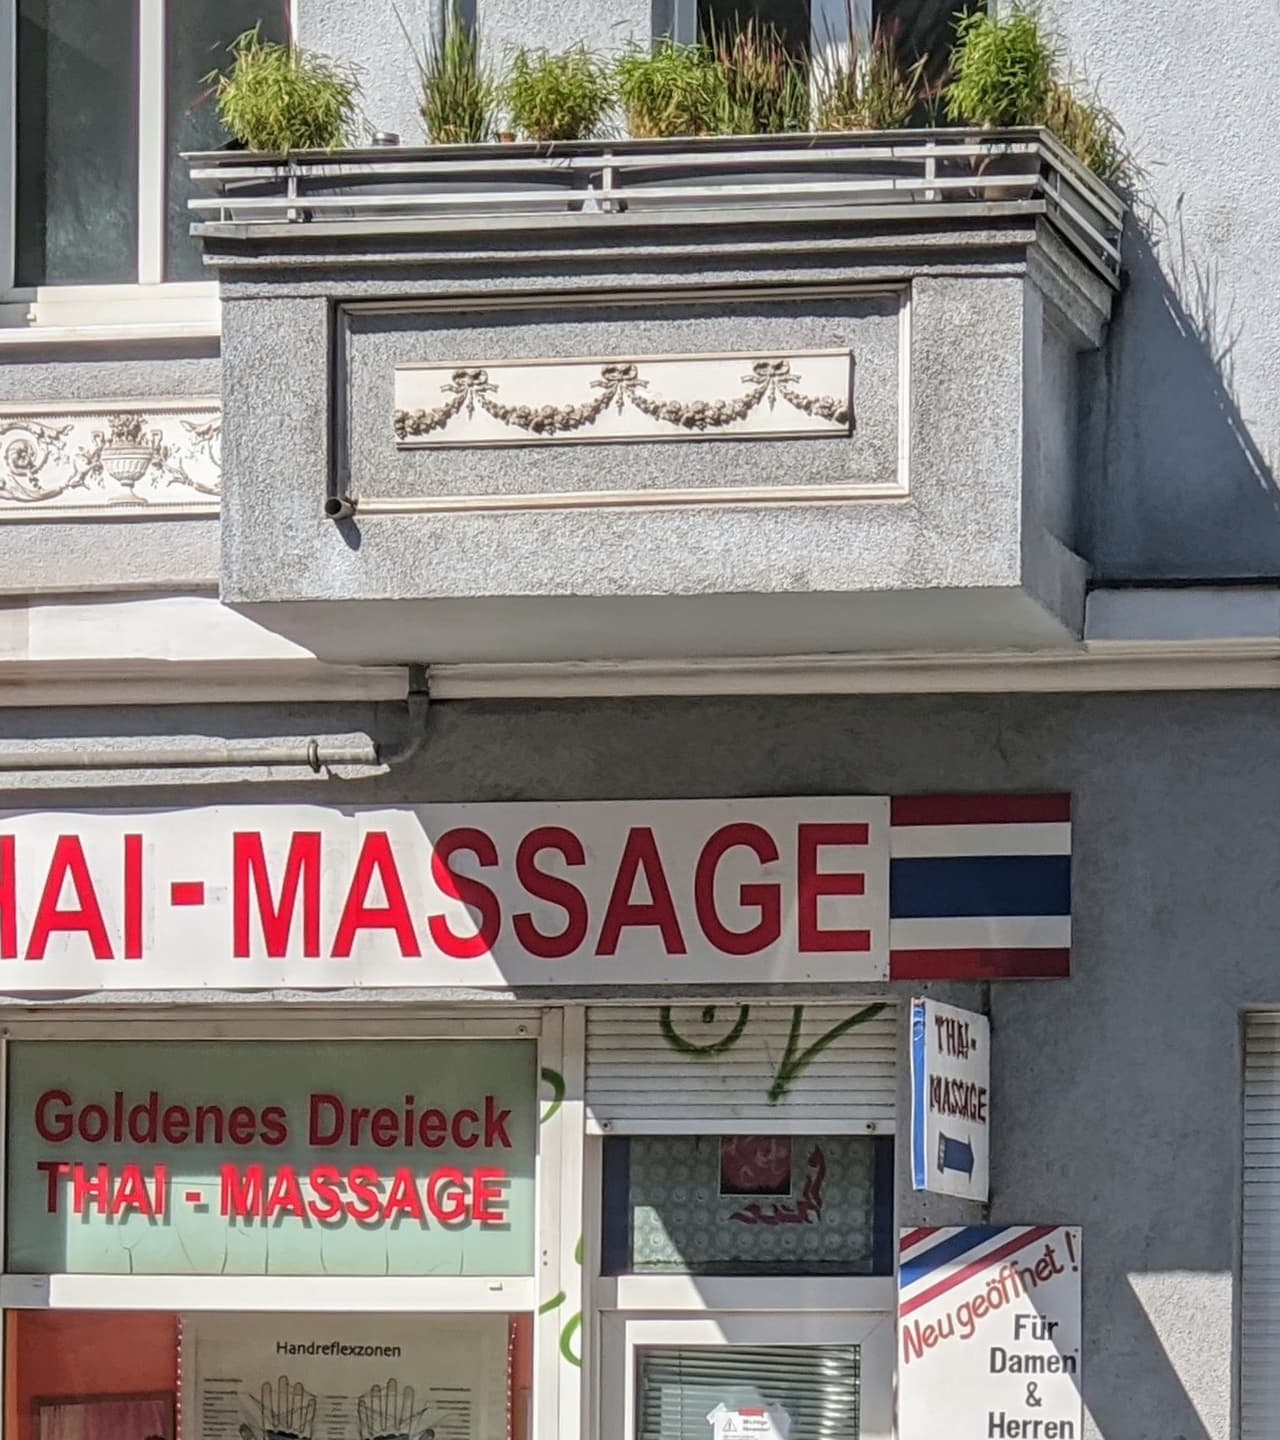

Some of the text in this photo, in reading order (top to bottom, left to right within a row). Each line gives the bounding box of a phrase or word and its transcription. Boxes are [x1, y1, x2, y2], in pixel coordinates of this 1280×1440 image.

[929, 1074, 988, 1124] MASSAGE
[34, 1089, 513, 1149] Goldenes Dreieck
[36, 1161, 166, 1216] THAI
[220, 1163, 506, 1222] MASSAGE
[1013, 1313, 1059, 1341] Für
[276, 1341, 401, 1359] Handreflexzonen
[989, 1347, 1077, 1374] Damen
[1025, 1380, 1042, 1407] &
[988, 1411, 1074, 1439] Herren
